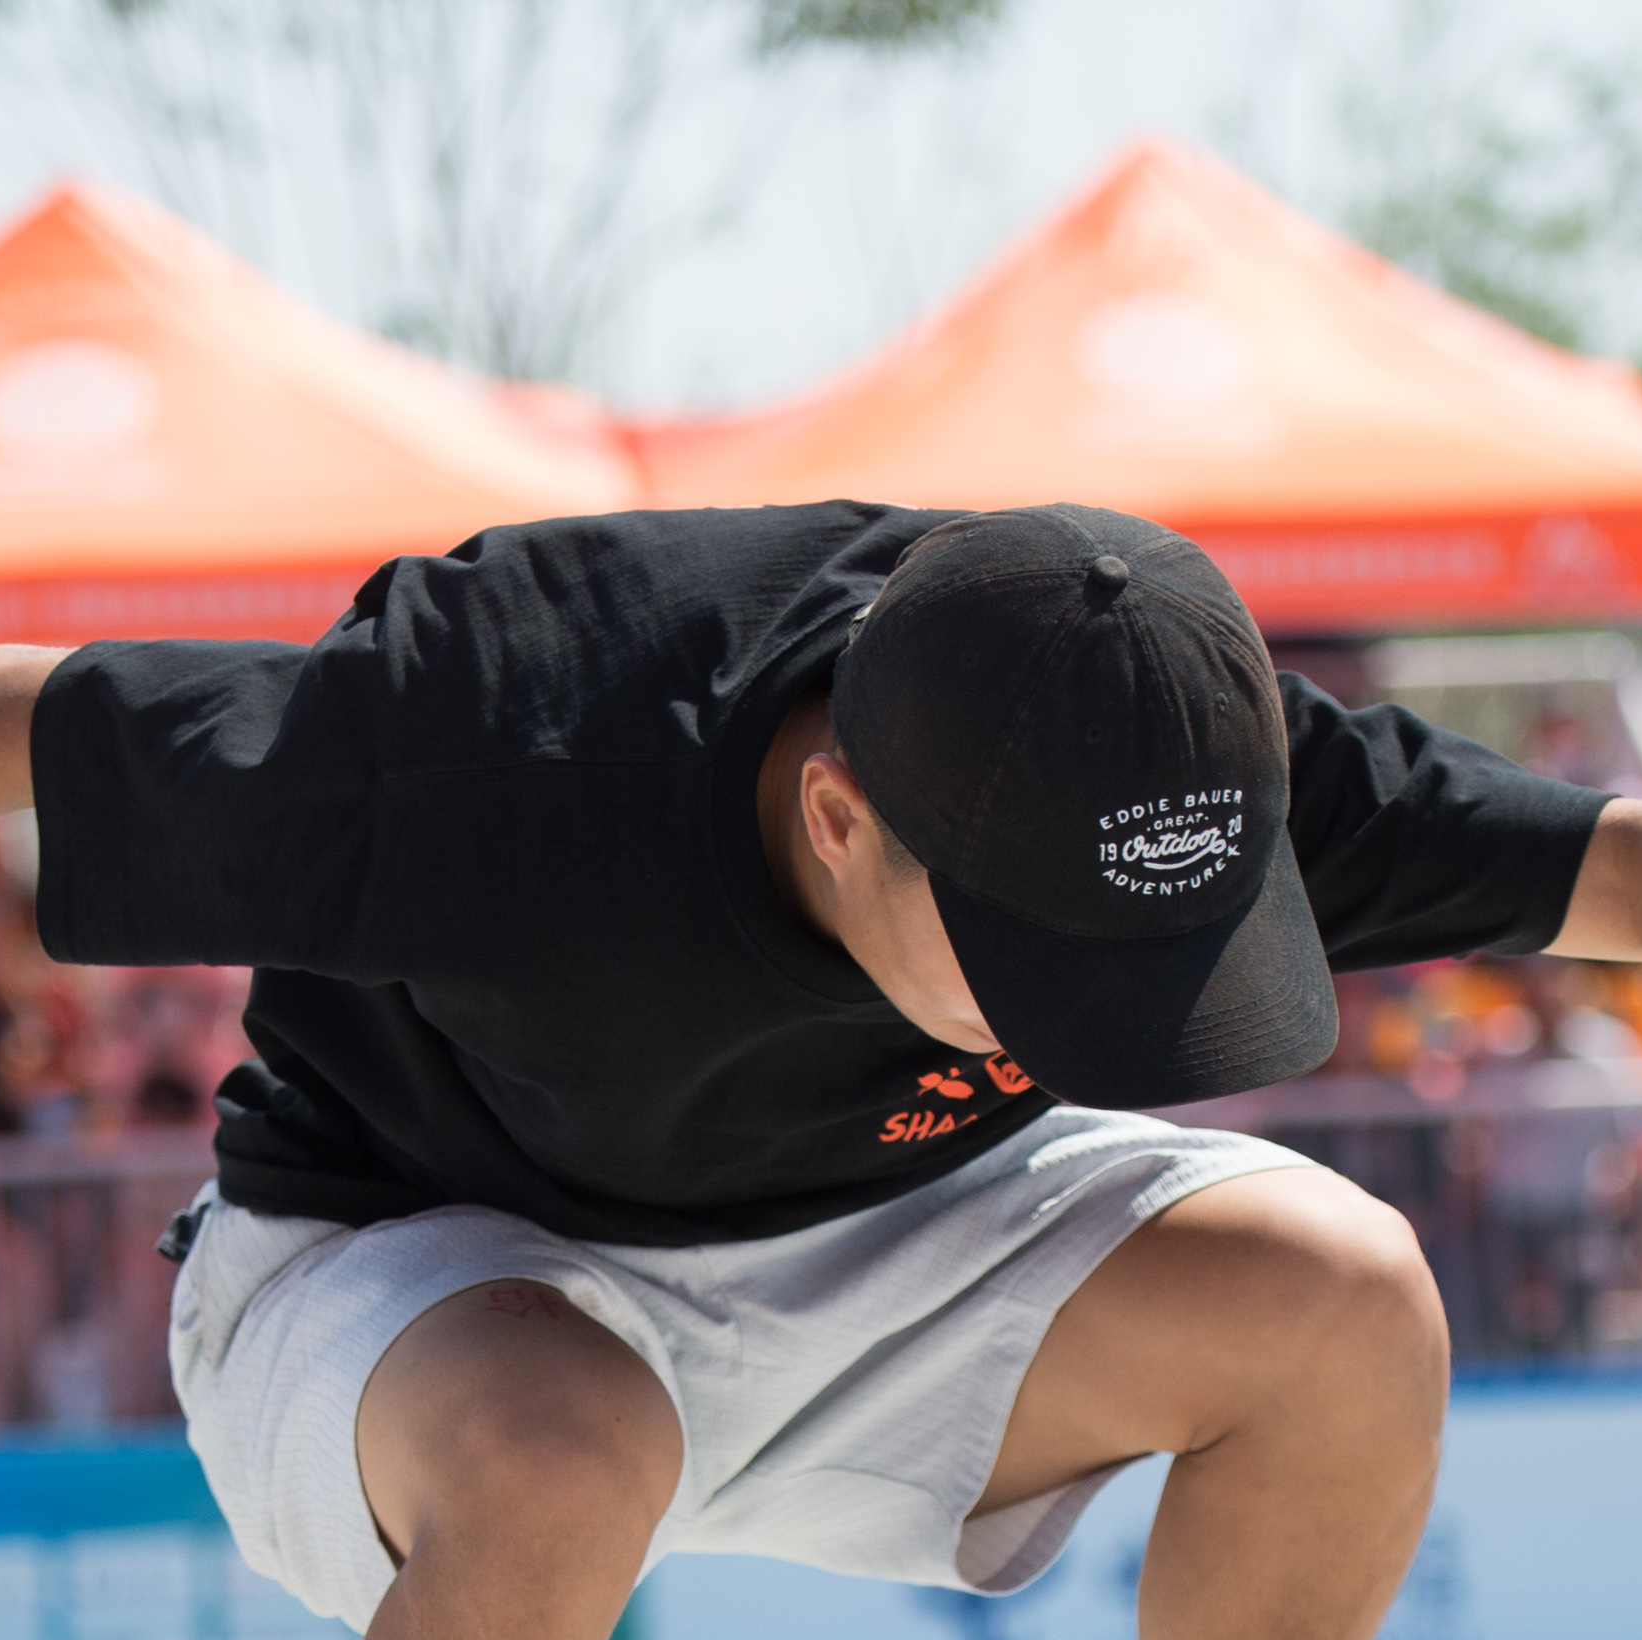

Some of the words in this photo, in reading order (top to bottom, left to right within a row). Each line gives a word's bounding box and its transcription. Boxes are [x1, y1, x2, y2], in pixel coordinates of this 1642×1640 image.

[1099, 798, 1171, 831] EDDIE
[1184, 788, 1244, 808] BAUER
[1099, 842, 1118, 863] 19
[1121, 827, 1227, 871] Outdoor
[878, 1109, 979, 1143] SHA
